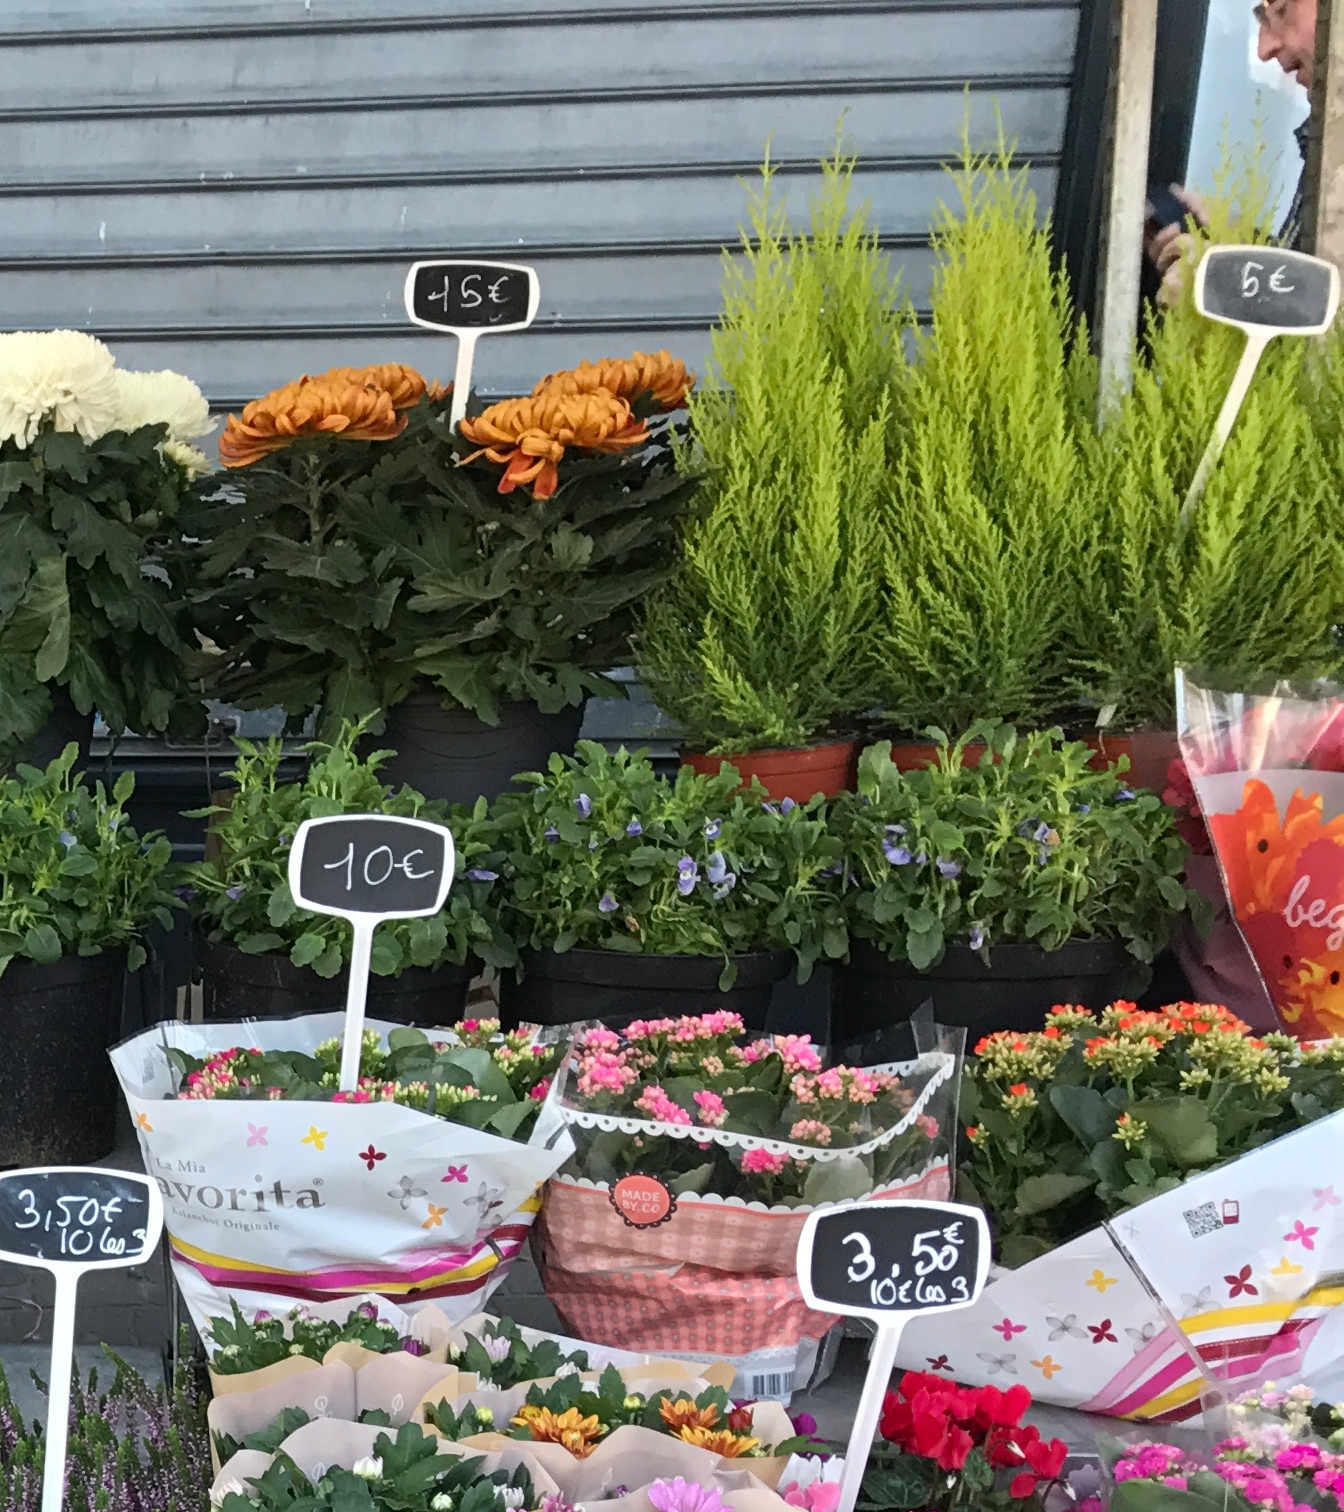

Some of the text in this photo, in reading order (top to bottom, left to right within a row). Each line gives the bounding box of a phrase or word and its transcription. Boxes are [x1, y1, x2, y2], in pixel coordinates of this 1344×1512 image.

[427, 273, 510, 313] 15€
[1240, 260, 1296, 298] 5€
[323, 842, 435, 891] 10€
[178, 1159, 207, 1174] Mia
[14, 1189, 123, 1233] 3,50€
[622, 1189, 661, 1202] MADE
[60, 1227, 94, 1256] 10
[125, 1228, 147, 1255] 3
[870, 1276, 913, 1306] 10€
[949, 1275, 971, 1303] 3
